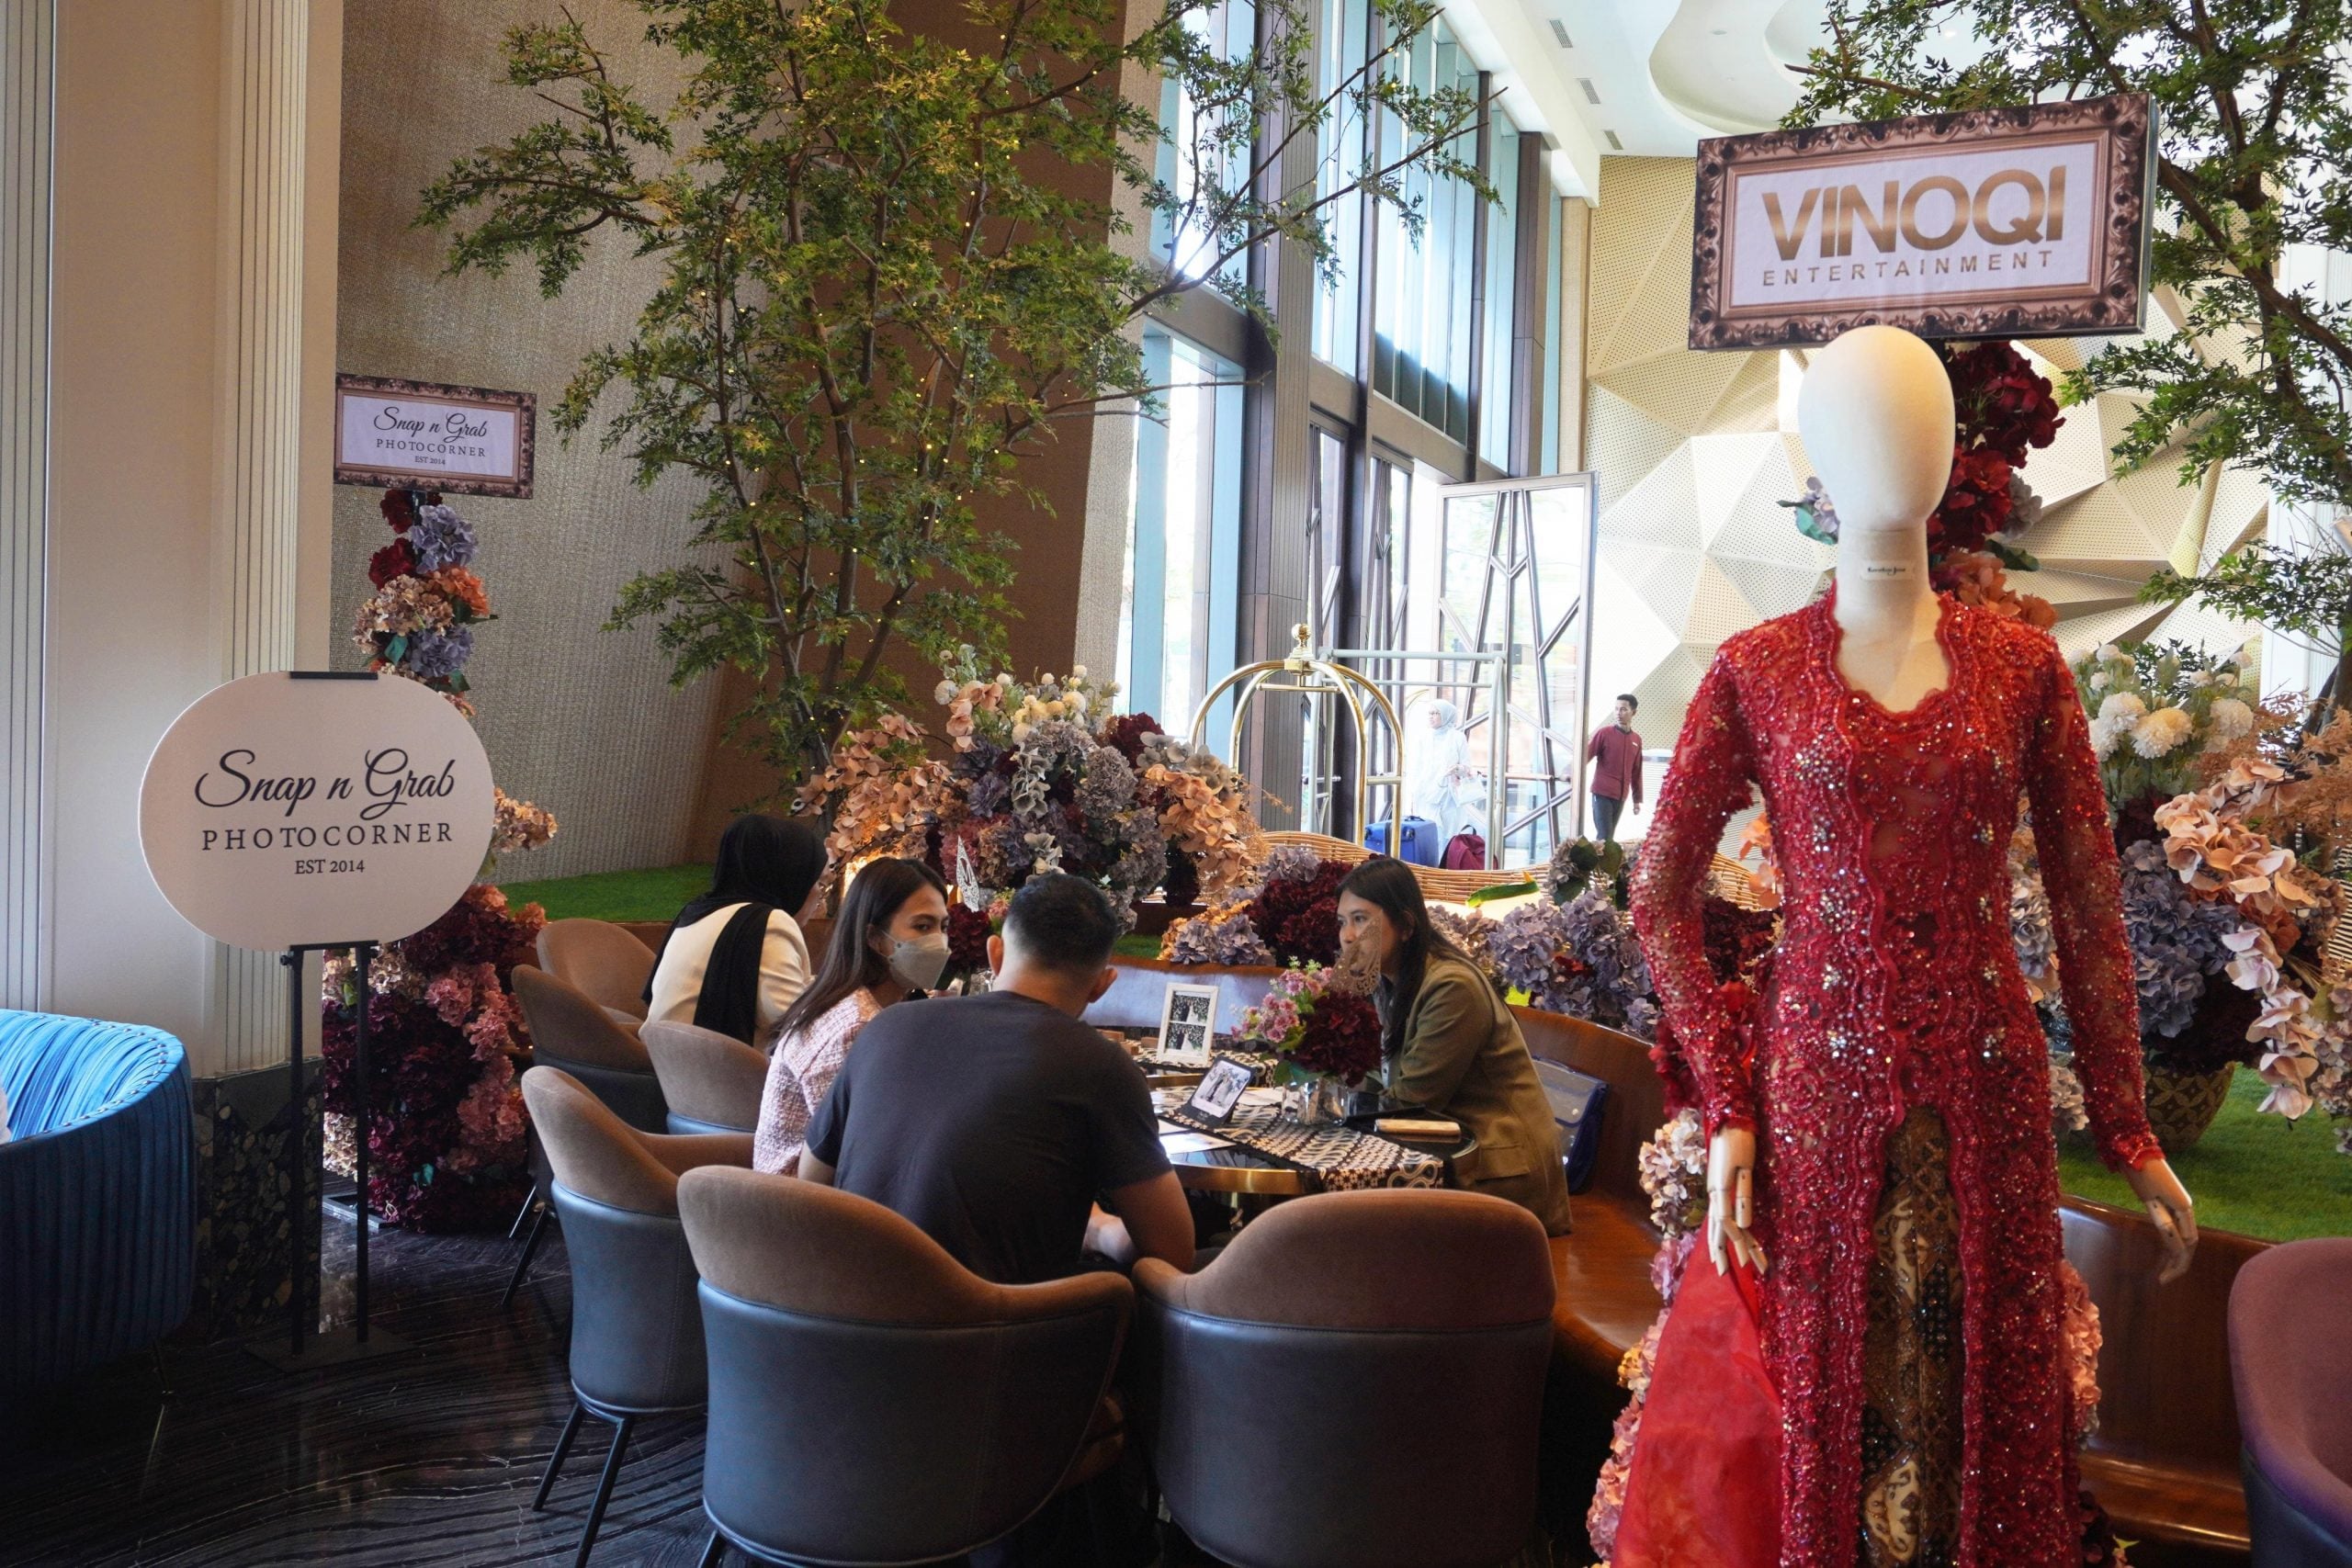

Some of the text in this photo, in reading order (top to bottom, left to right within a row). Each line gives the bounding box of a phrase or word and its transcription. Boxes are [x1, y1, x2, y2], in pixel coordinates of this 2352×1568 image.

[1761, 164, 2066, 261] VINOQI
[1762, 250, 2053, 288] ENTERTAINMENT
[374, 406, 488, 443] Snap n Grab
[376, 438, 486, 457] PHOTOCORNER
[414, 456, 429, 464] EST
[195, 748, 456, 820] Snap n Grab
[201, 822, 453, 851] PHOTOCORNER
[294, 859, 365, 874] EST 2014
